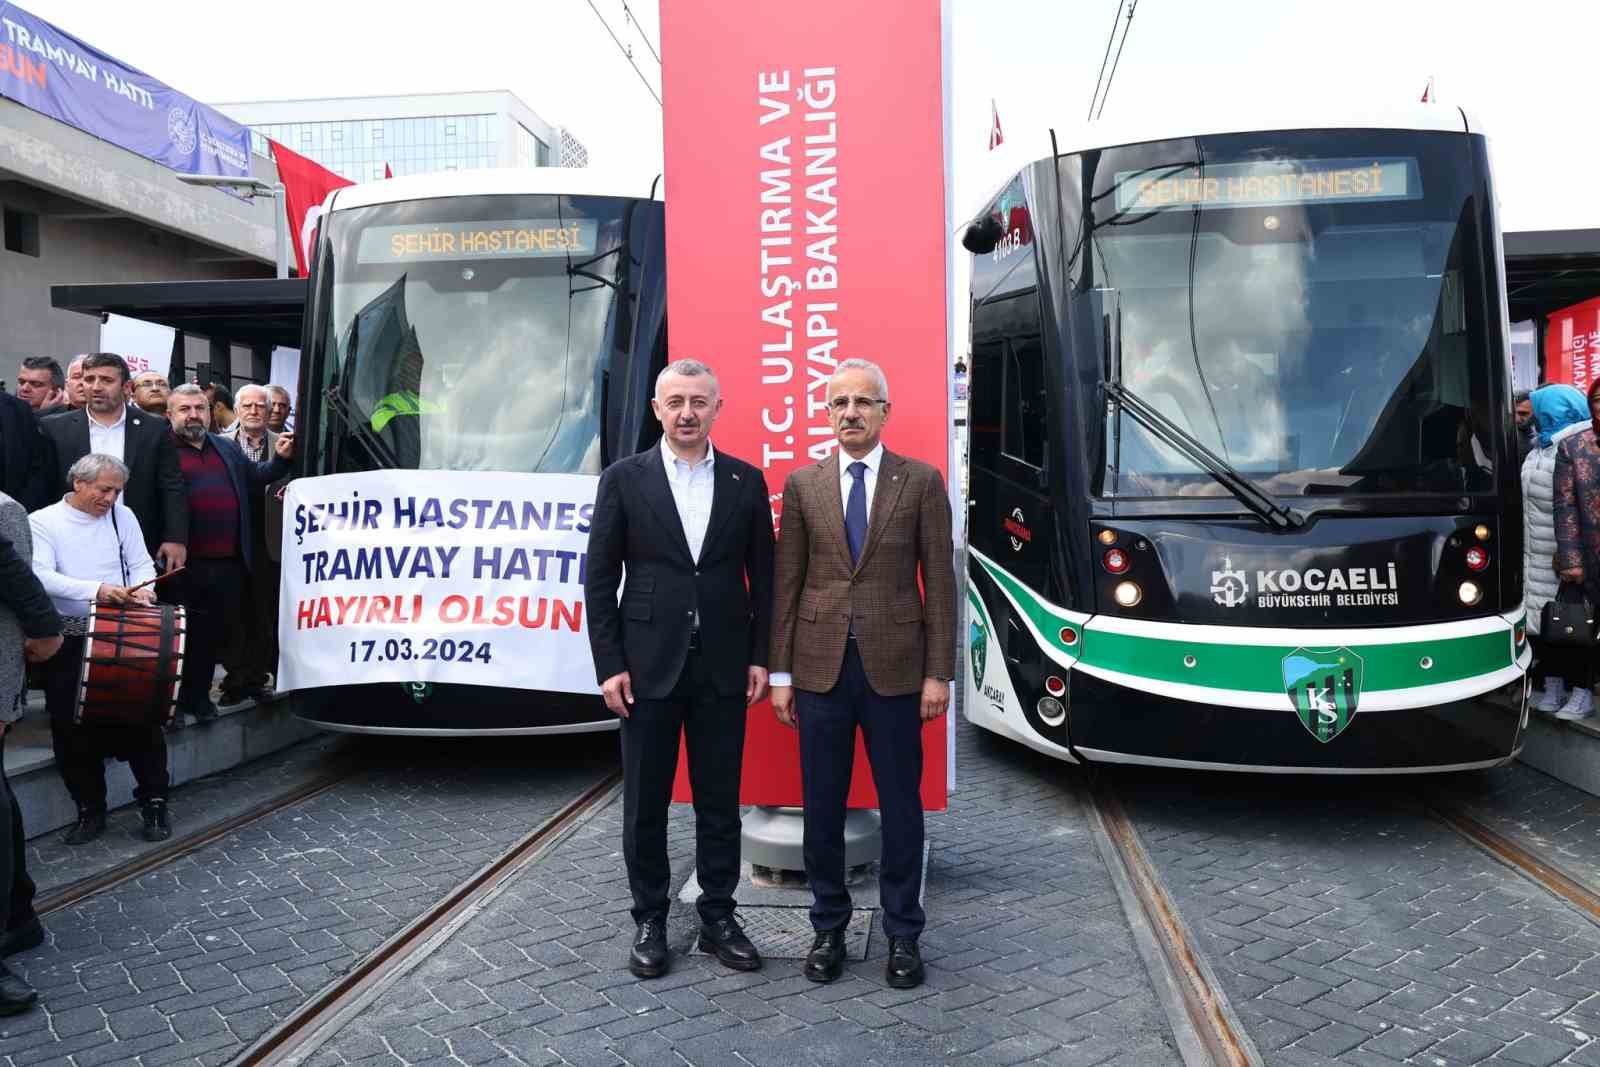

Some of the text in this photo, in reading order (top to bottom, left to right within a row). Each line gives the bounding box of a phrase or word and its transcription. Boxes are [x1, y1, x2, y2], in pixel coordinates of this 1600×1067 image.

[2, 17, 153, 109] TRAMVAY HATTI
[758, 70, 791, 126] VE
[796, 66, 838, 290] BAKANLIĞI
[1136, 161, 1384, 208] ŞEHİR HASTANESİ
[391, 221, 581, 258] ŞEHİR HASTANESİ
[760, 135, 802, 385] ULAŞTIRMA
[763, 395, 795, 469] T.C.
[294, 490, 383, 545] ŞEHİR
[302, 545, 588, 585] TRAMVAY HATTI
[1256, 561, 1398, 592] KOCAELİ
[297, 594, 583, 633] HAYIRLI OLSUN
[1337, 591, 1399, 606] BELEDİYESİ
[350, 638, 492, 664] 17.03.2024
